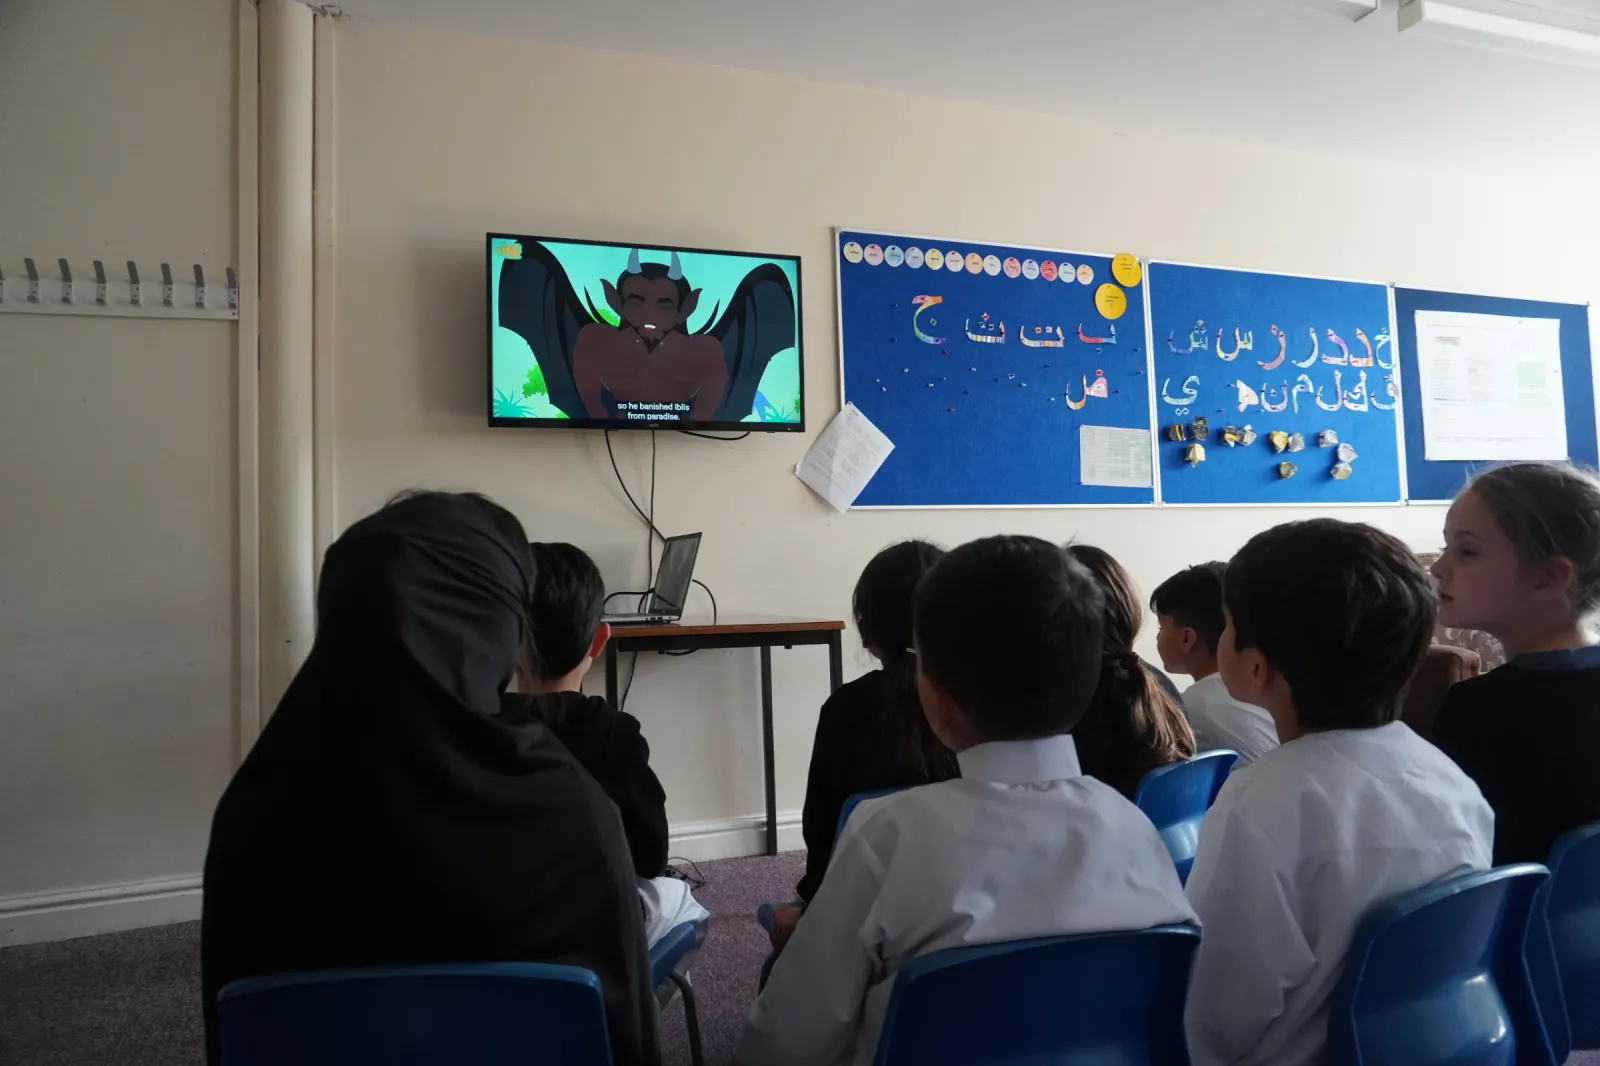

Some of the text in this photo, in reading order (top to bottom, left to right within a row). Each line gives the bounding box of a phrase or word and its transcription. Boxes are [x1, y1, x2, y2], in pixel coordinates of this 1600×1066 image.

[911, 295, 946, 345] ج
[965, 312, 1006, 344] ث
[1019, 325, 1065, 348] ت
[1167, 319, 1209, 355] ش
[1215, 326, 1253, 362] س
[1257, 323, 1287, 371] ز
[1290, 327, 1319, 369] ر
[1349, 327, 1375, 367] د
[628, 402, 638, 410] he
[639, 402, 673, 411] banished
[674, 402, 690, 411] Iblis
[1065, 369, 1108, 411] ض
[1162, 375, 1201, 417] ي
[1261, 379, 1288, 413] ن
[1291, 373, 1314, 415] م
[1315, 369, 1343, 412] ل
[1342, 369, 1369, 412] ك
[627, 411, 681, 421] from paradise.
